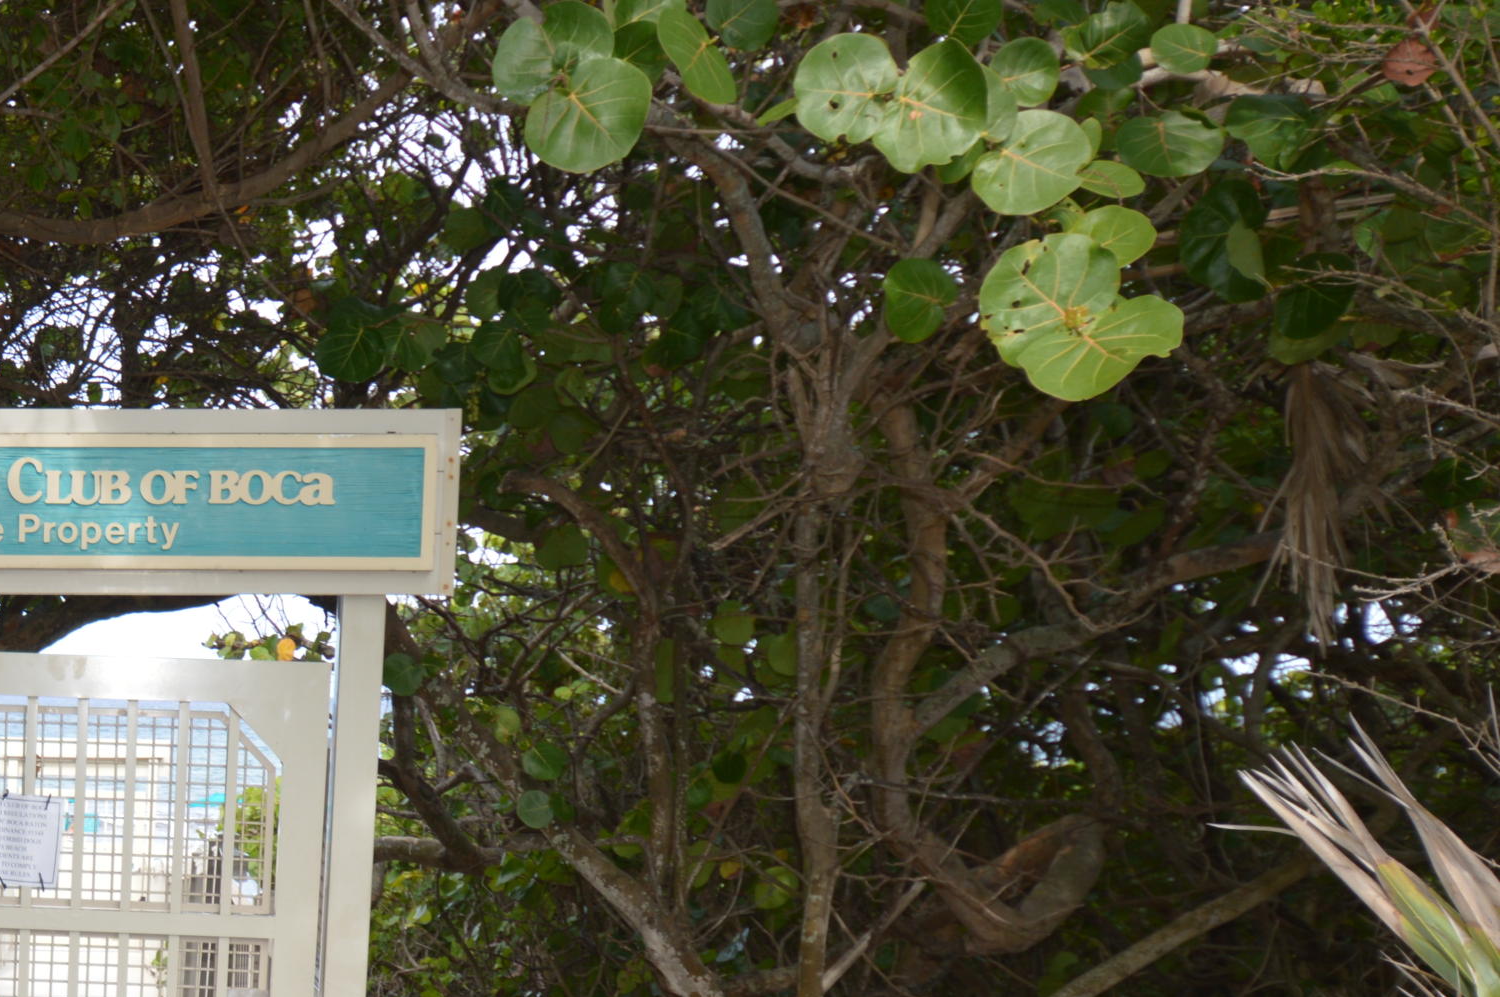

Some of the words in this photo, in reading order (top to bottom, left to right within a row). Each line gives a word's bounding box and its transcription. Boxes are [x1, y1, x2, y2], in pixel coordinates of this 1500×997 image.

[6, 456, 133, 506] CLUB
[139, 469, 200, 505] OF
[18, 513, 181, 550] Property
